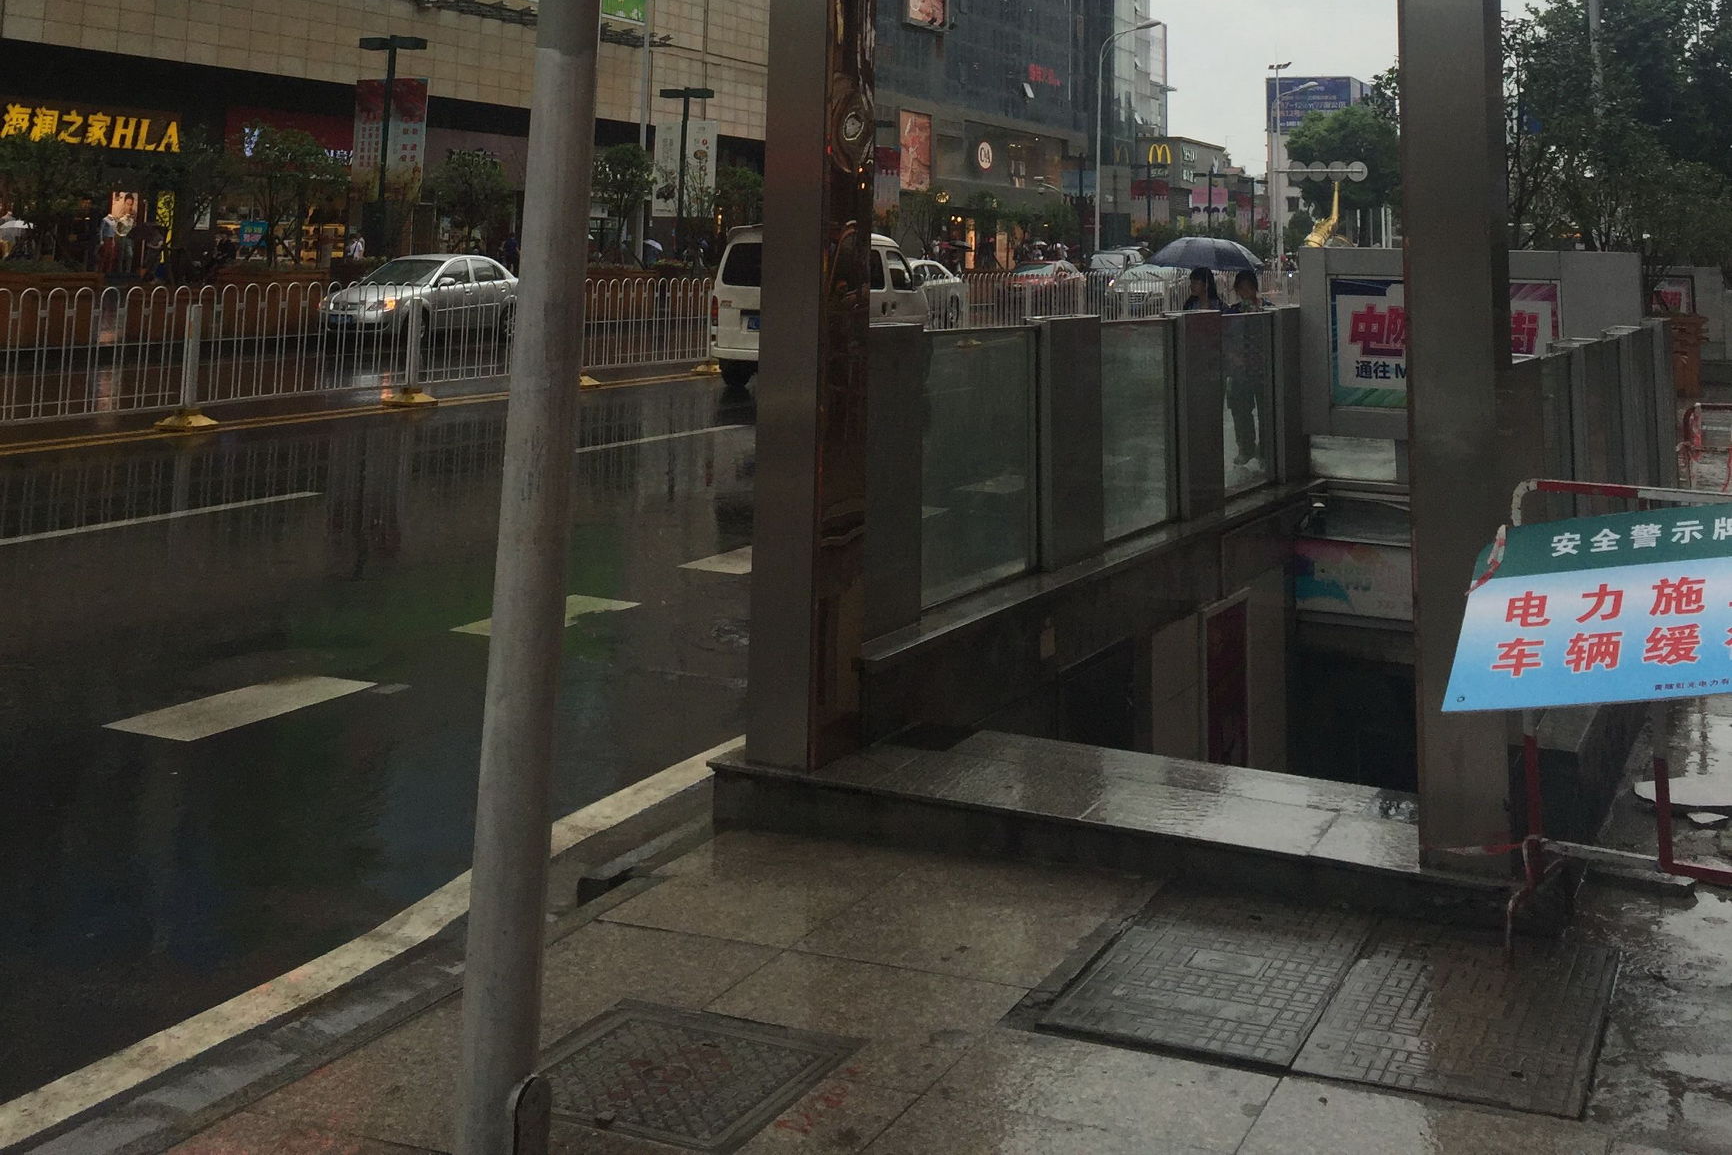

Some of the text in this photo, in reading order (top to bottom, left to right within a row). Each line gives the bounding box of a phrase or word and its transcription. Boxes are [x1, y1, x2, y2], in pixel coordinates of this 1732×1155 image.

[1355, 360, 1390, 379] 通往
[1505, 577, 1732, 627] 电力施
